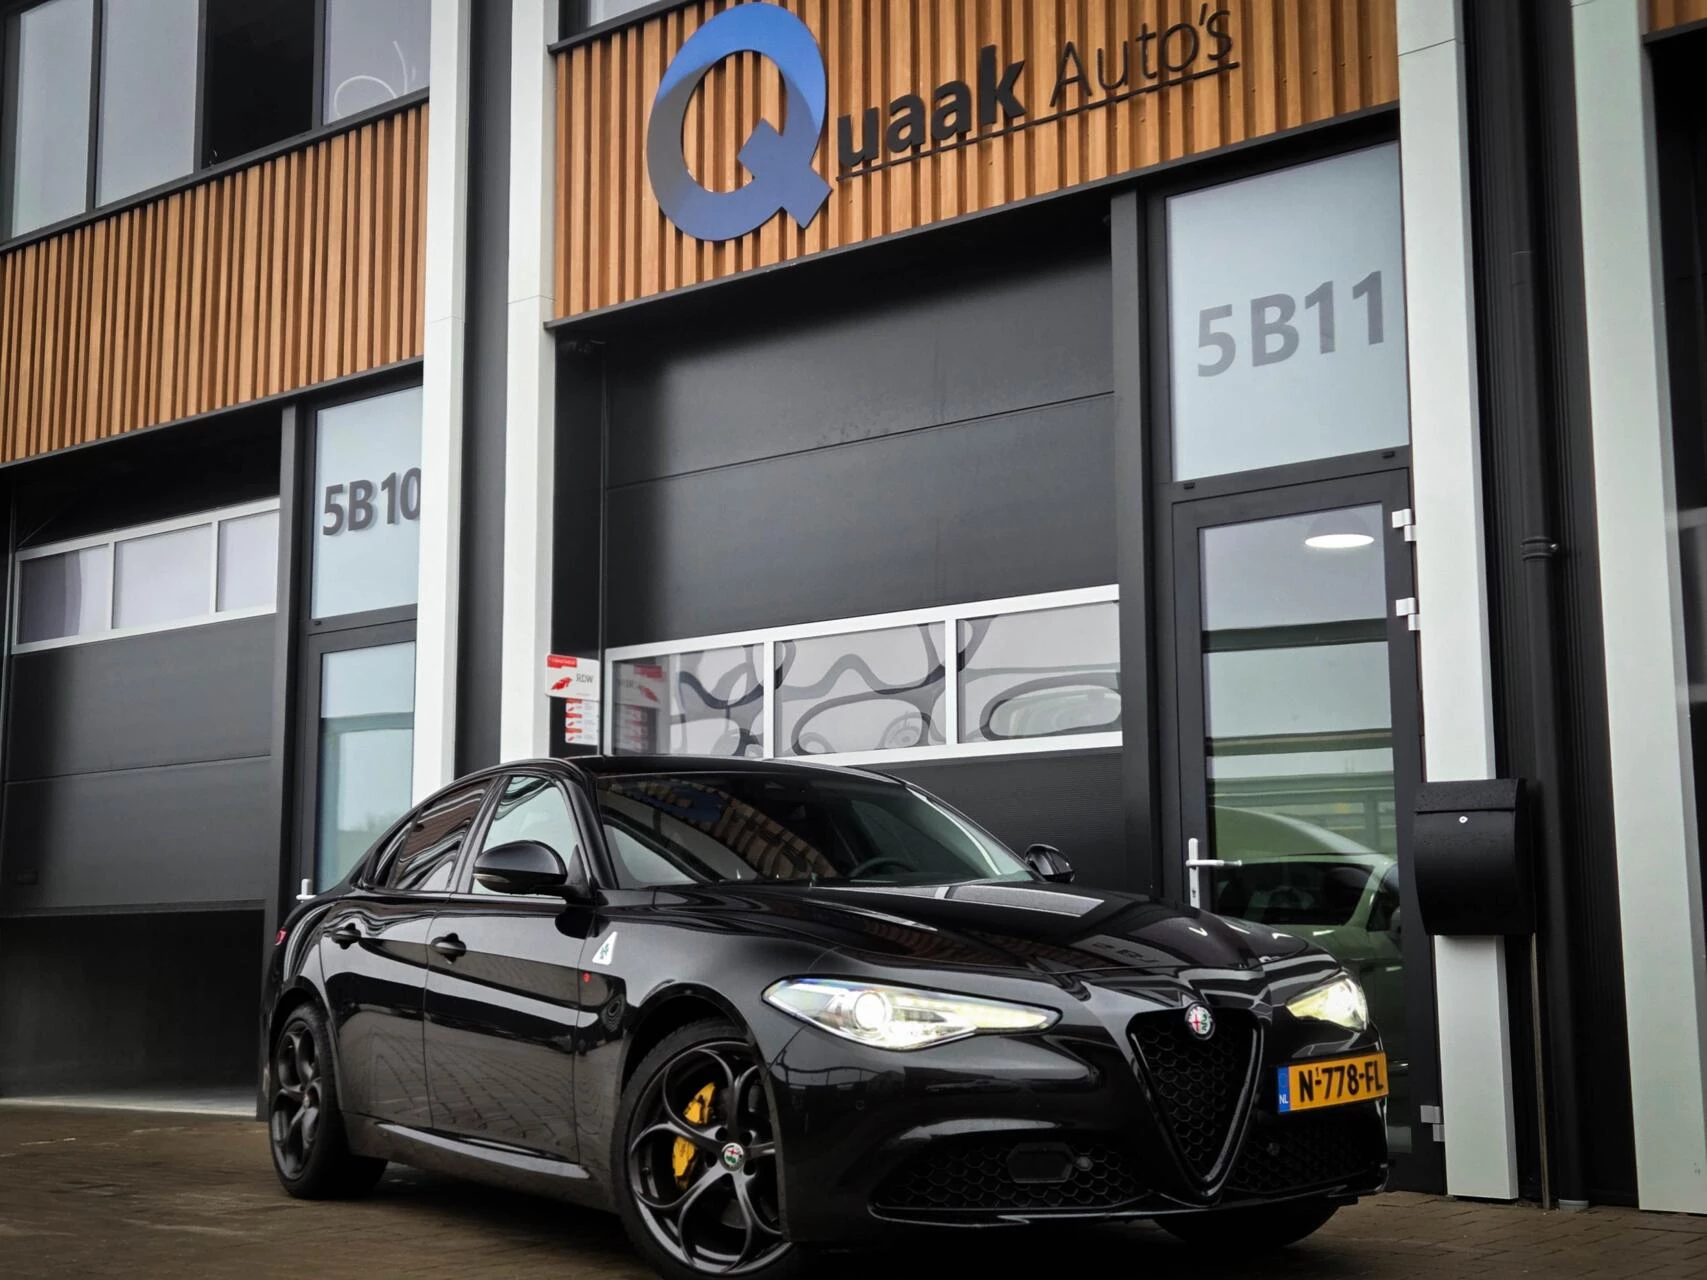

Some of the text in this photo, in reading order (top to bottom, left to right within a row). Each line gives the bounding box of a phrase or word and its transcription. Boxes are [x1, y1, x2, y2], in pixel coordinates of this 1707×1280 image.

[647, 2, 1232, 241] Quaak Auto's
[1198, 270, 1384, 377] 5B11
[323, 467, 421, 536] 5B10
[1279, 1094, 1289, 1104] NL
